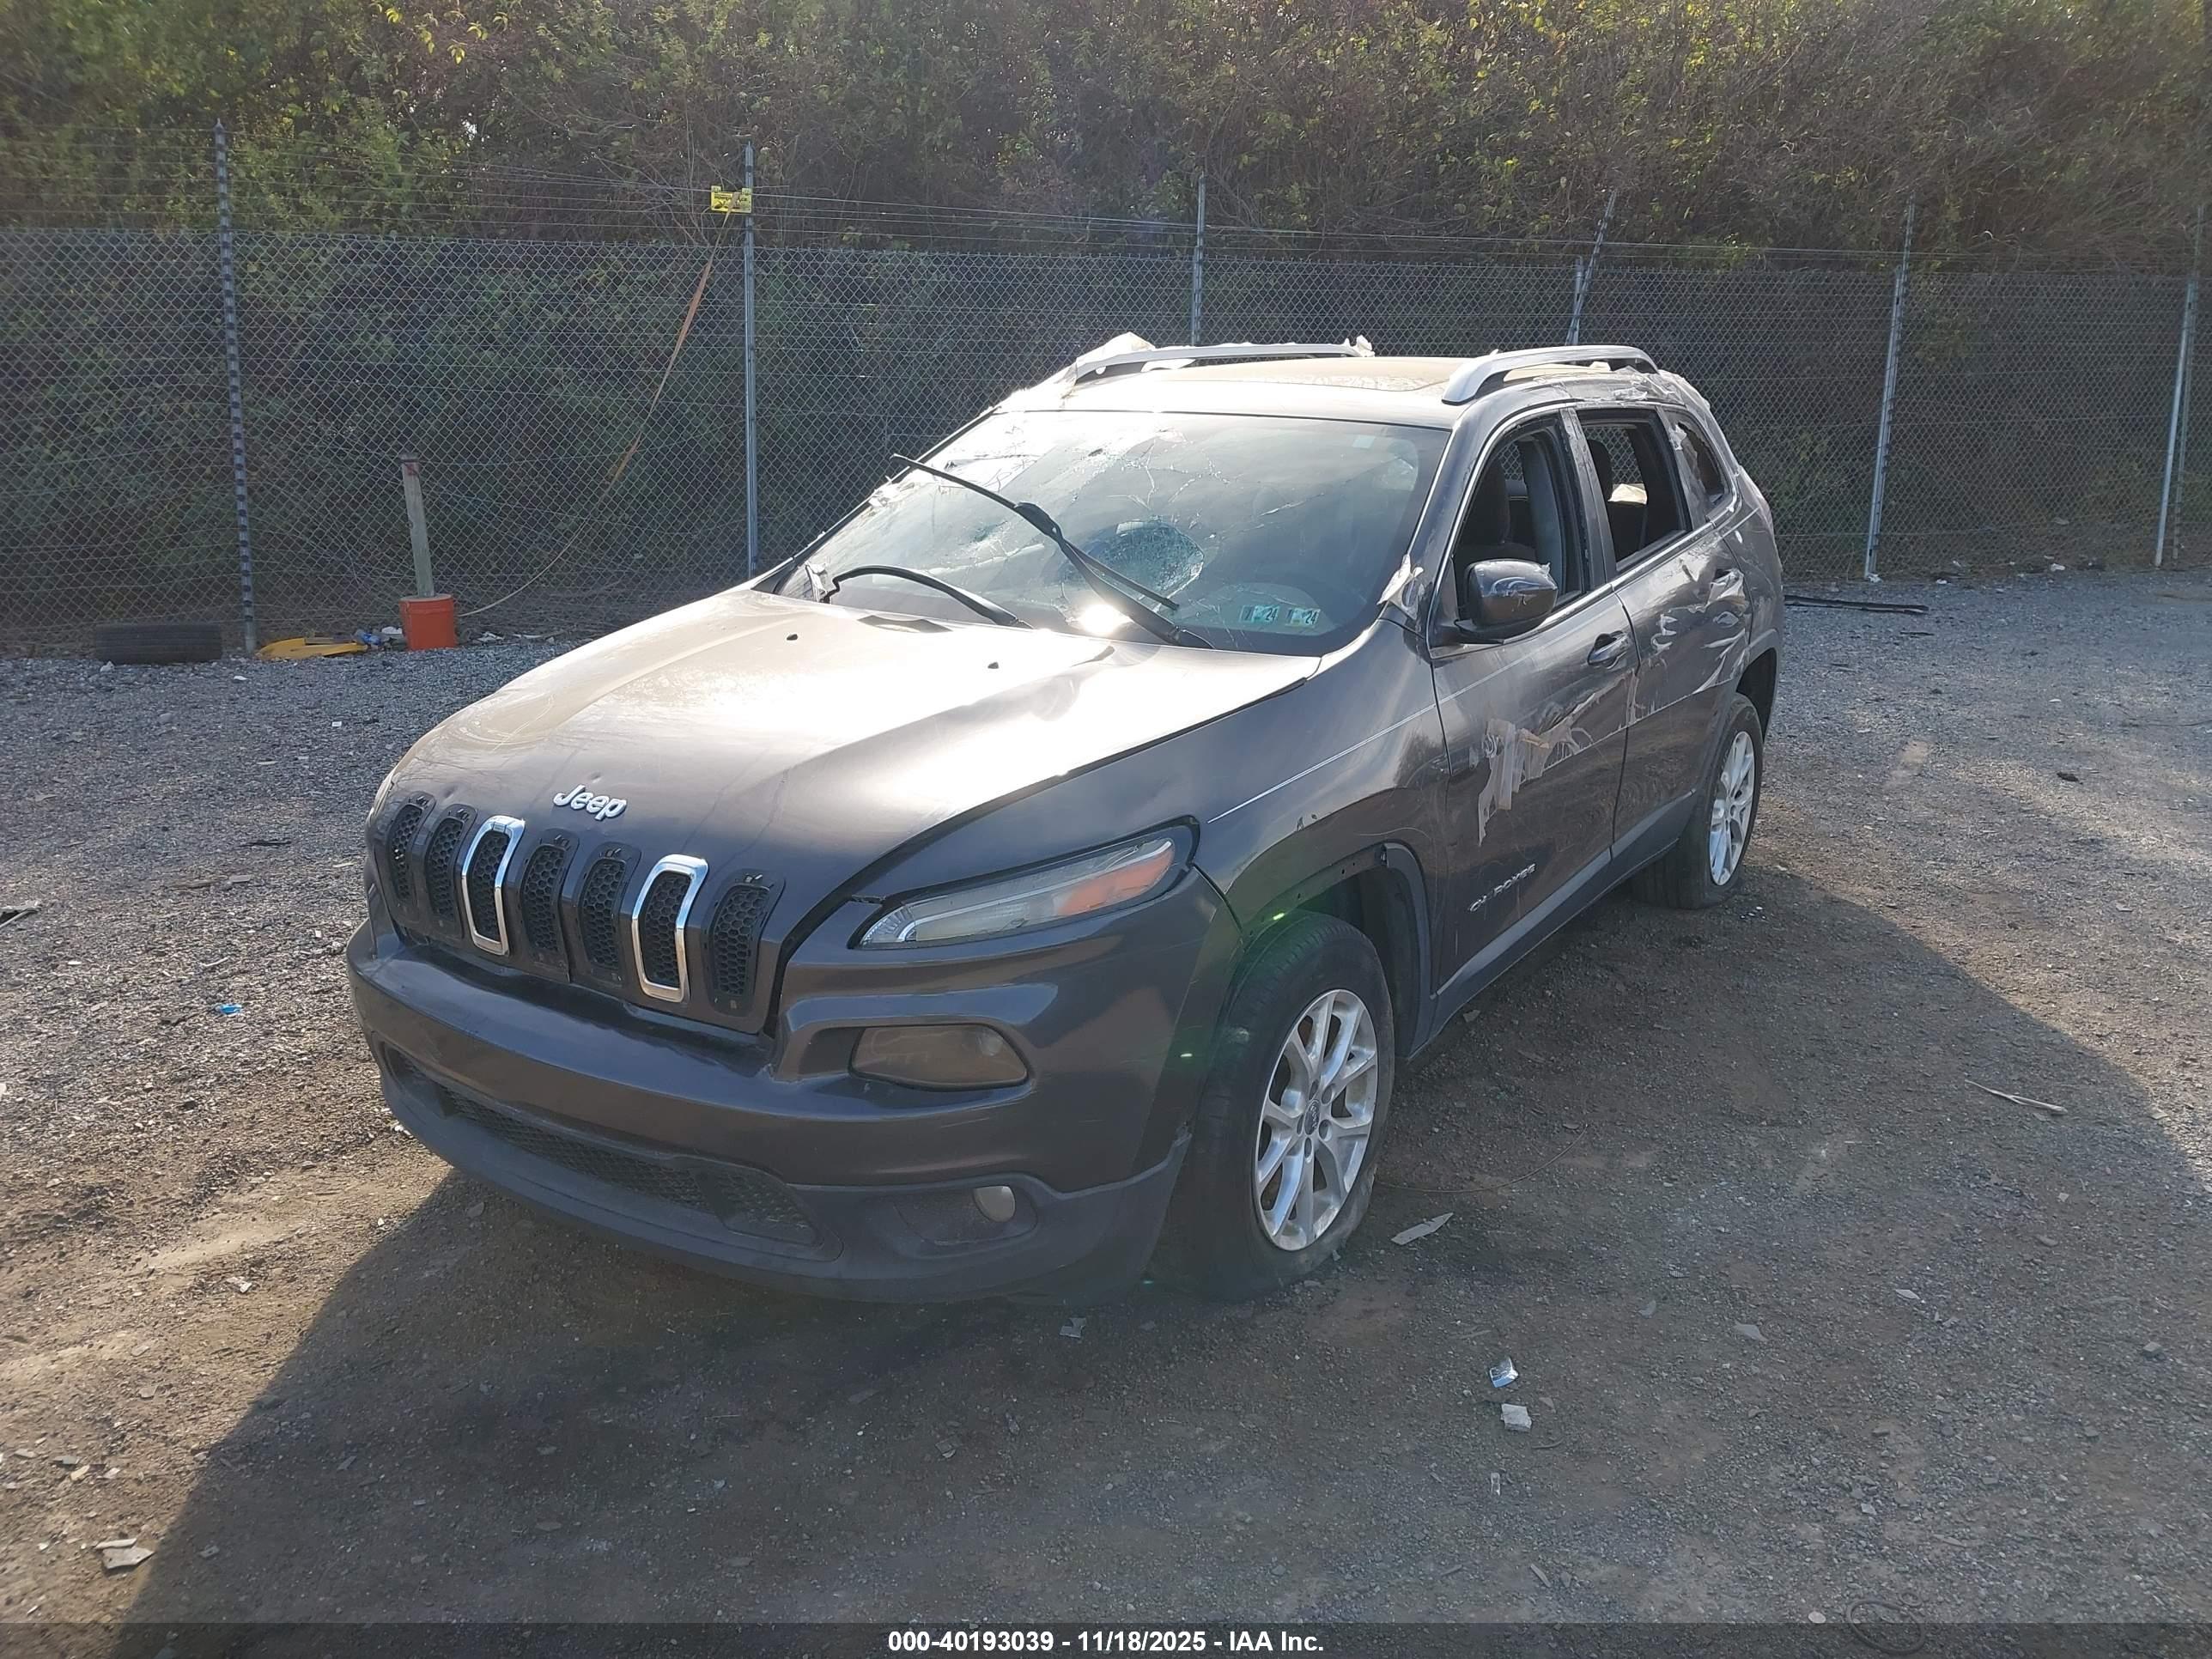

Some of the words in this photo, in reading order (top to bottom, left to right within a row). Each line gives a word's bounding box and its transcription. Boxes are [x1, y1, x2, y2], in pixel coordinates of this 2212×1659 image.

[1266, 607, 1278, 622] 24
[1305, 611, 1317, 624] 24
[553, 784, 627, 821] Jeep
